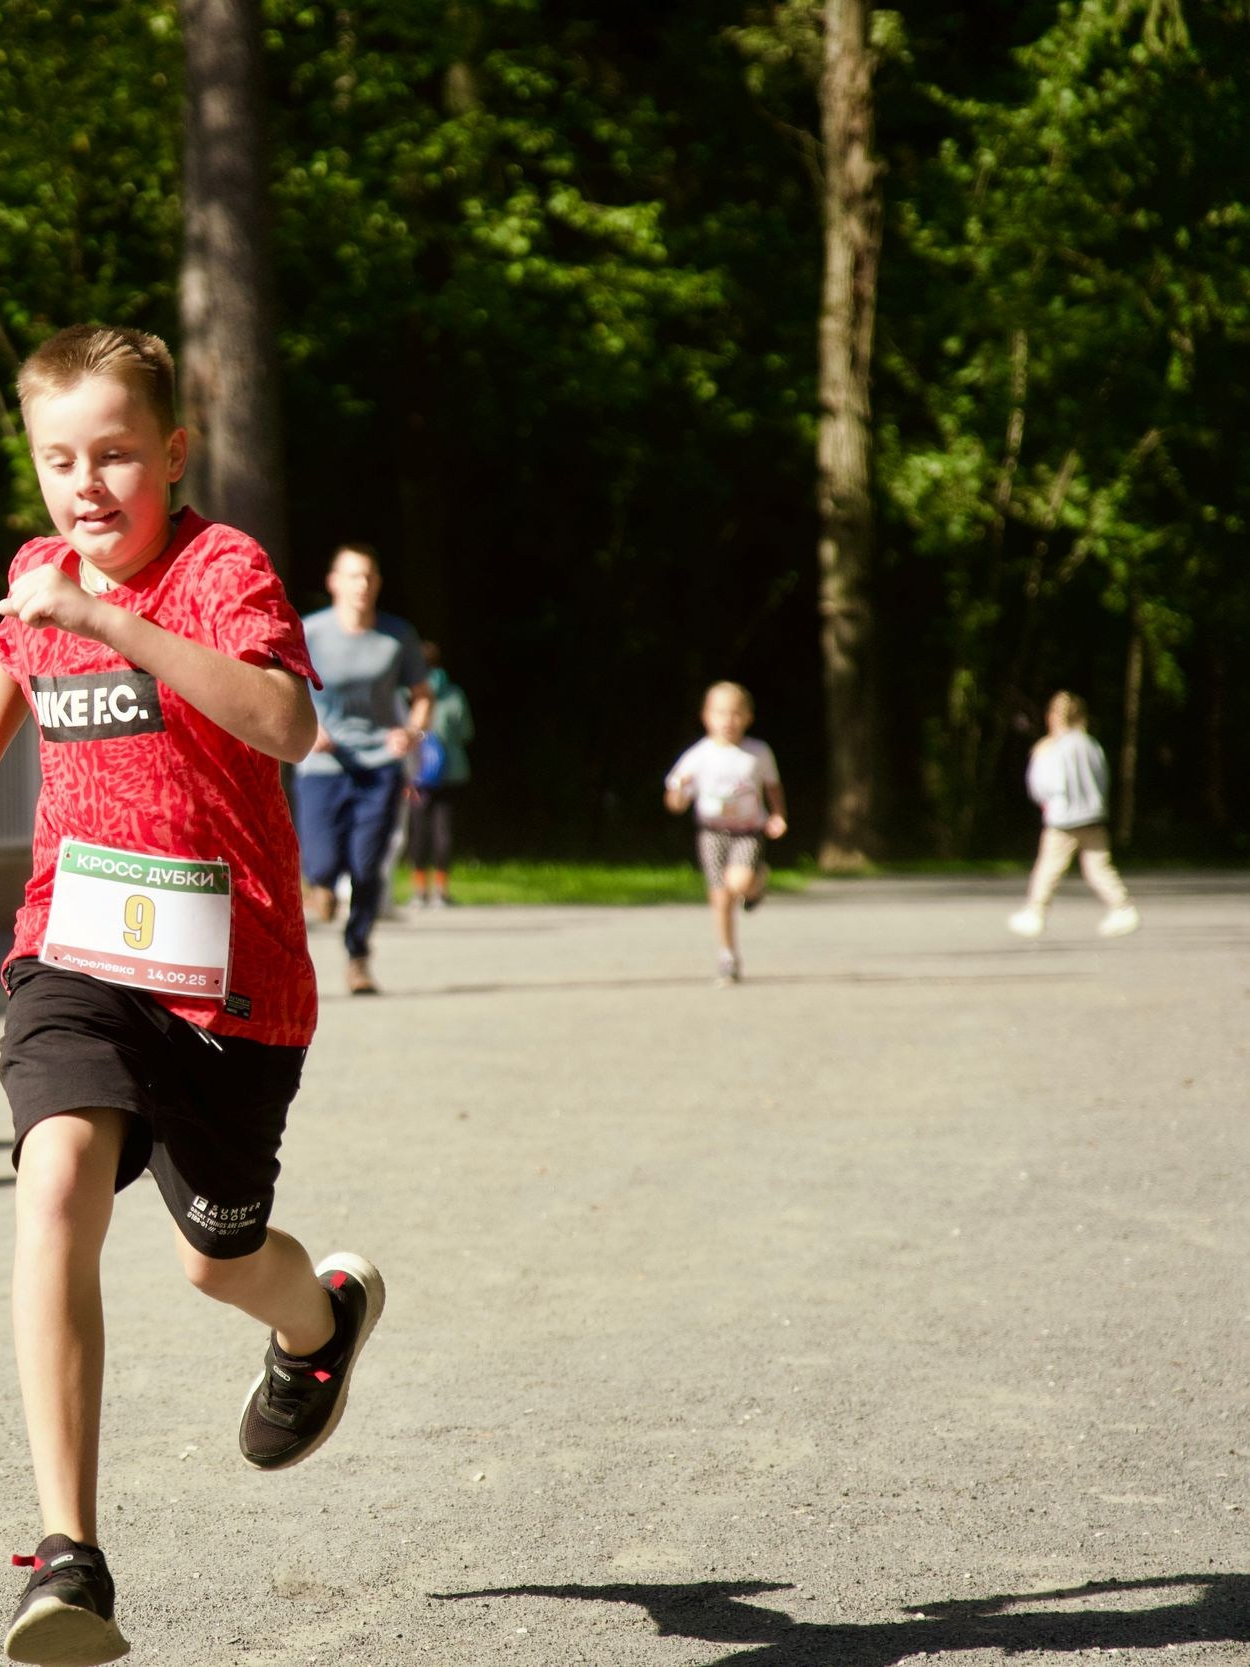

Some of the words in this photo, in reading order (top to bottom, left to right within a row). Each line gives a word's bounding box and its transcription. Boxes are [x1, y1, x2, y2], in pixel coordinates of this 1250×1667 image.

[93, 684, 149, 726] F.C.
[76, 853, 143, 879] КРОСС
[145, 867, 215, 887] ДУБКИ
[123, 894, 156, 950] 9
[62, 953, 135, 976] Апрелевка
[146, 968, 207, 986] 14.09.25
